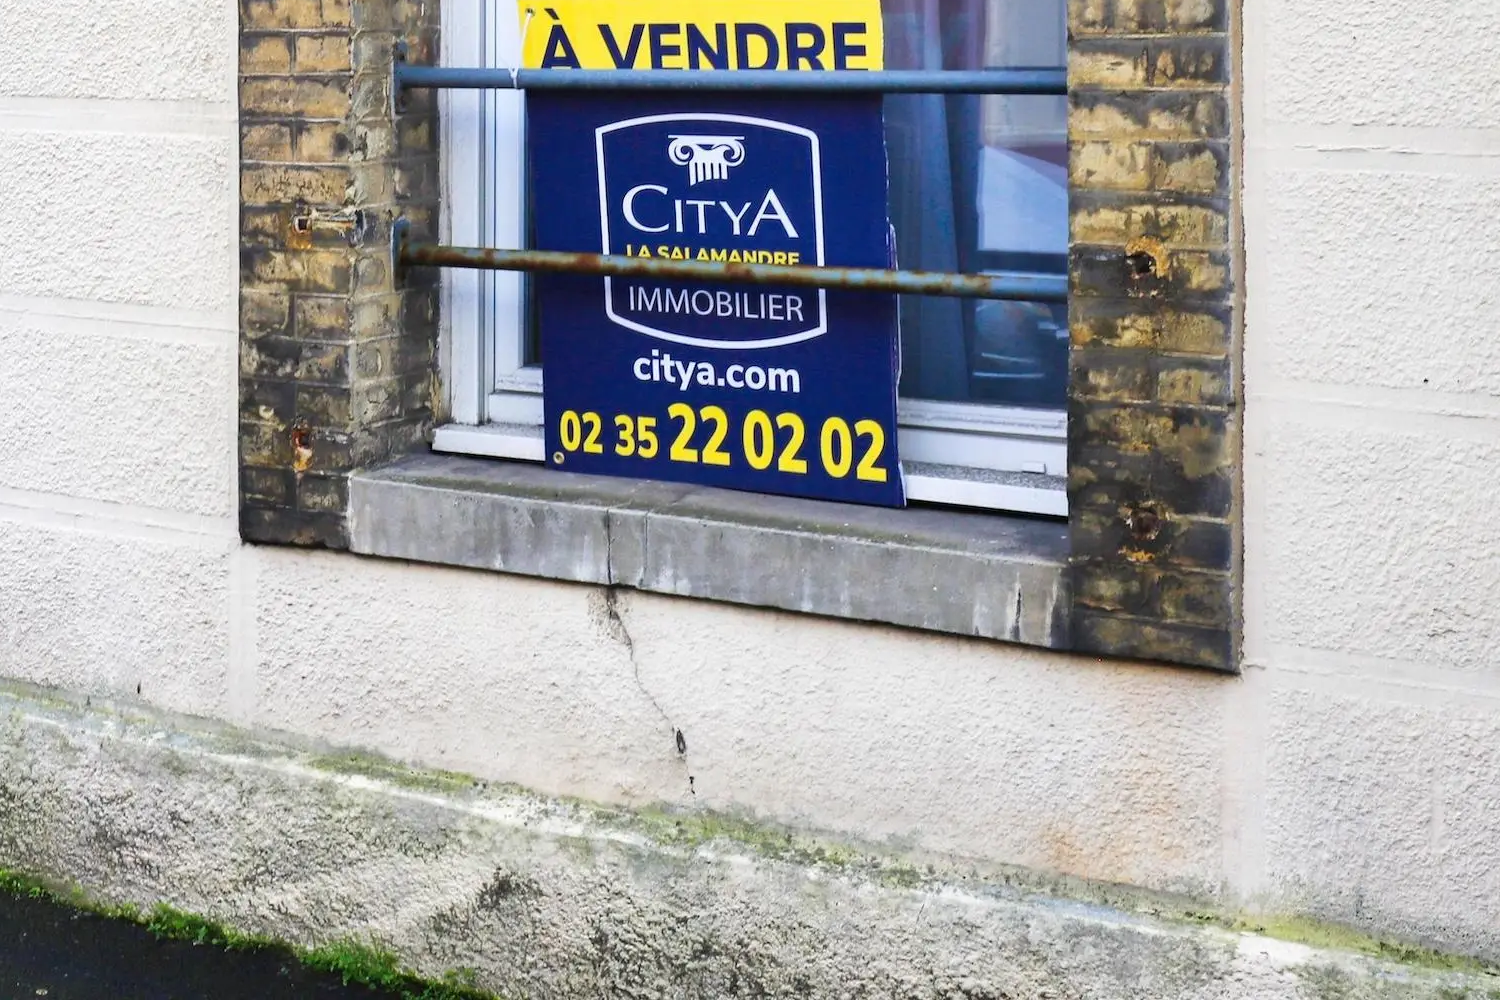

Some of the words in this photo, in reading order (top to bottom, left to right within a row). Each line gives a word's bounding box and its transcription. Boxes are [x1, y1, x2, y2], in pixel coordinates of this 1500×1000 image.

[540, 8, 582, 70] À
[597, 22, 868, 71] VENDRE
[629, 285, 804, 322] IMMOBILIER
[633, 349, 801, 393] citya.com
[559, 410, 603, 454] 02
[614, 414, 658, 458] 35
[668, 402, 730, 466] 22
[743, 409, 807, 474] 02
[821, 416, 887, 482] 02
